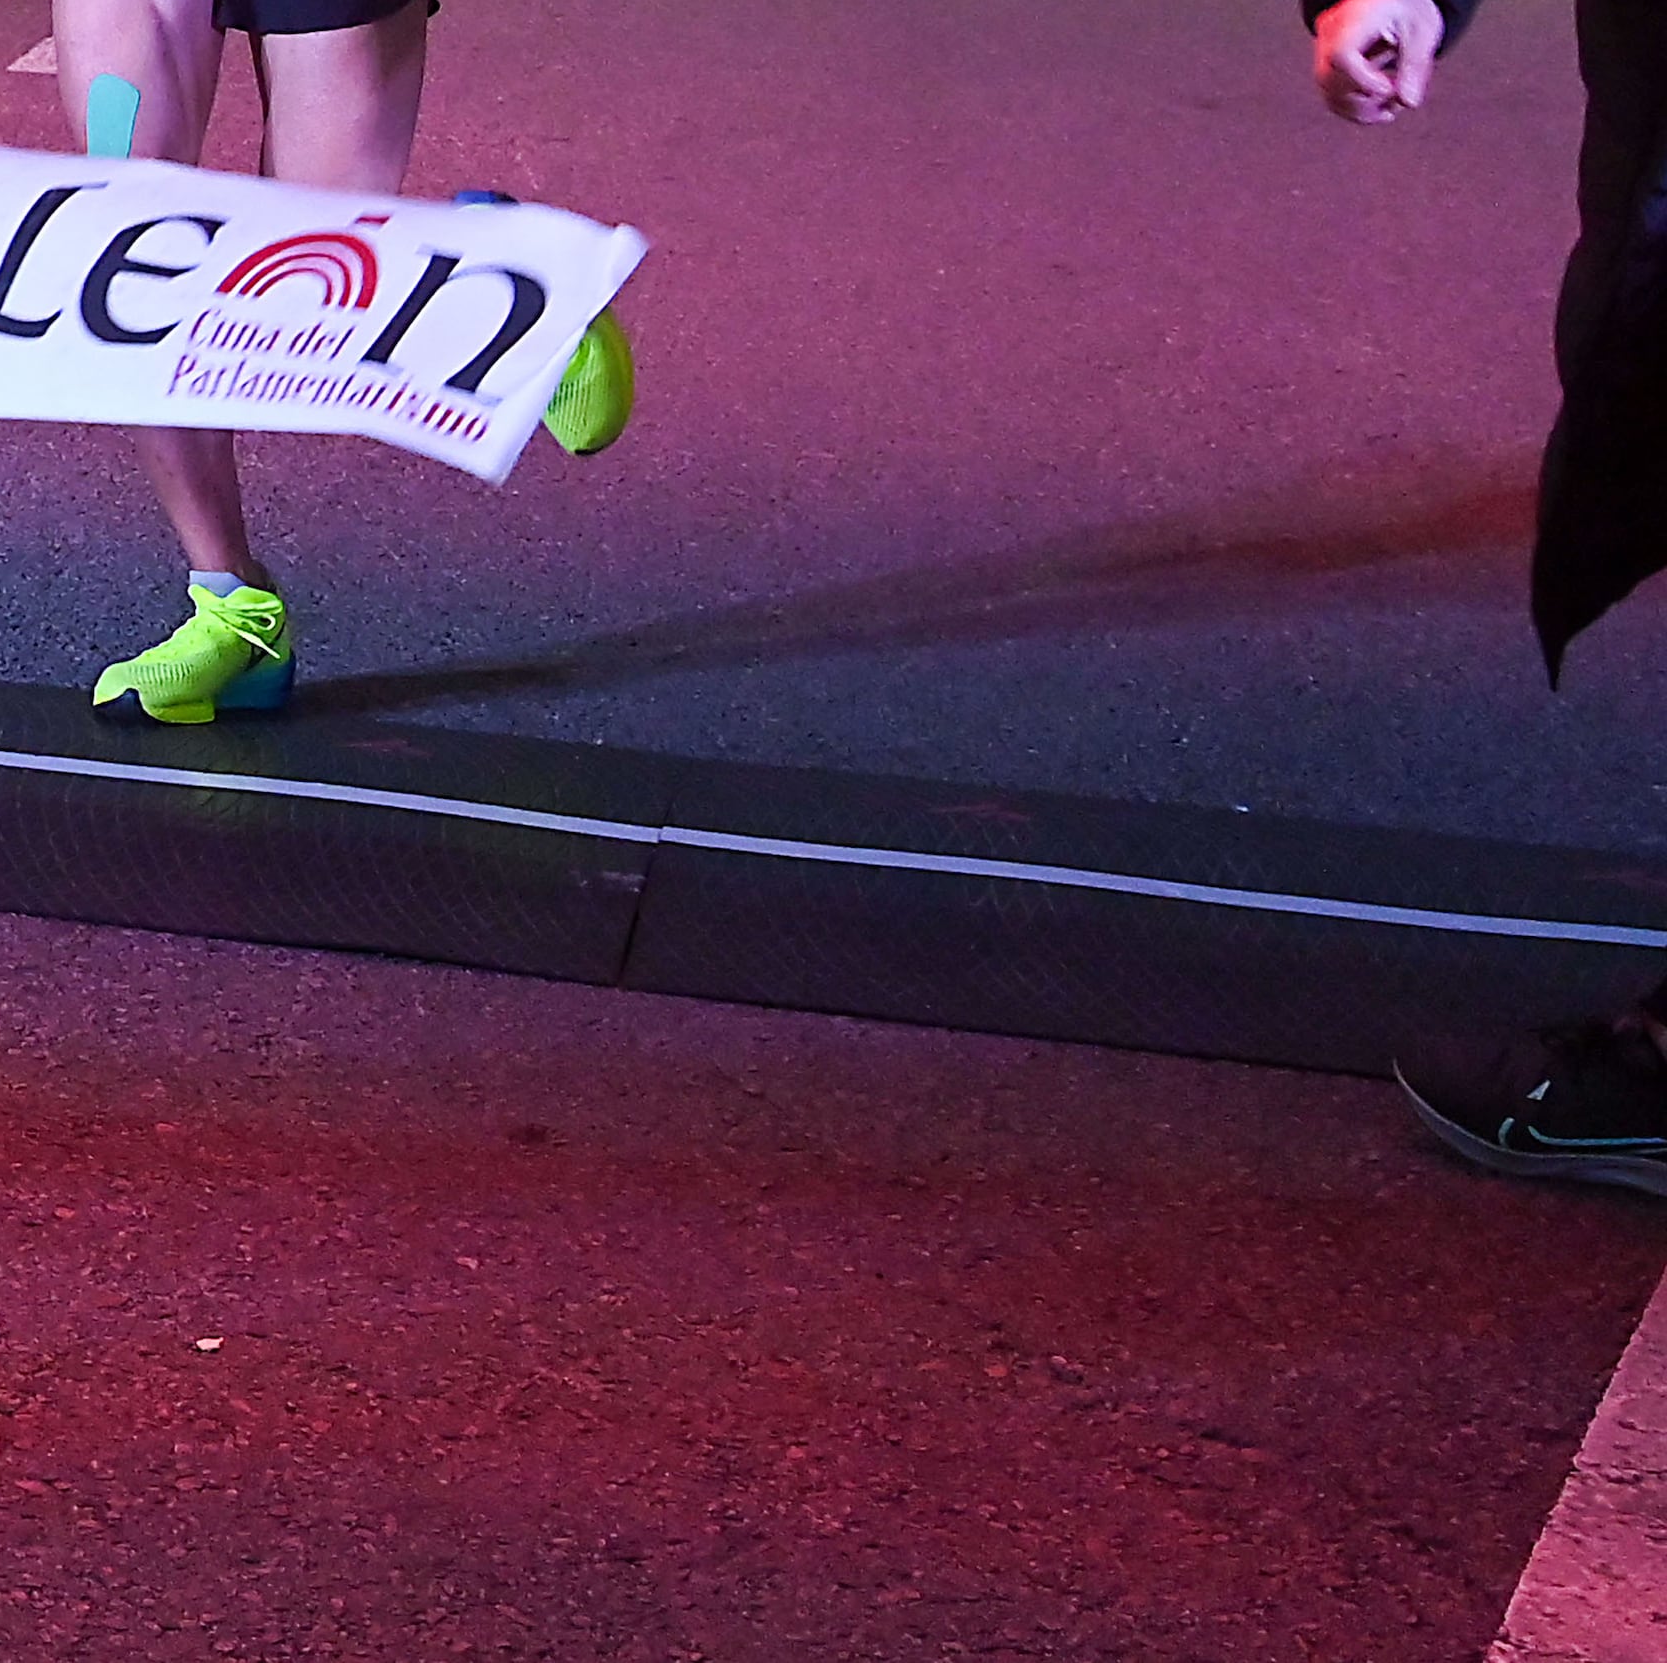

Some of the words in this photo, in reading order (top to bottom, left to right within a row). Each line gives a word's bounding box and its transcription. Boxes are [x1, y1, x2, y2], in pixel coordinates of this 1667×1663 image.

[188, 308, 281, 354] Cuna
[287, 316, 358, 361] del
[168, 353, 492, 443] Parlamentarismo
